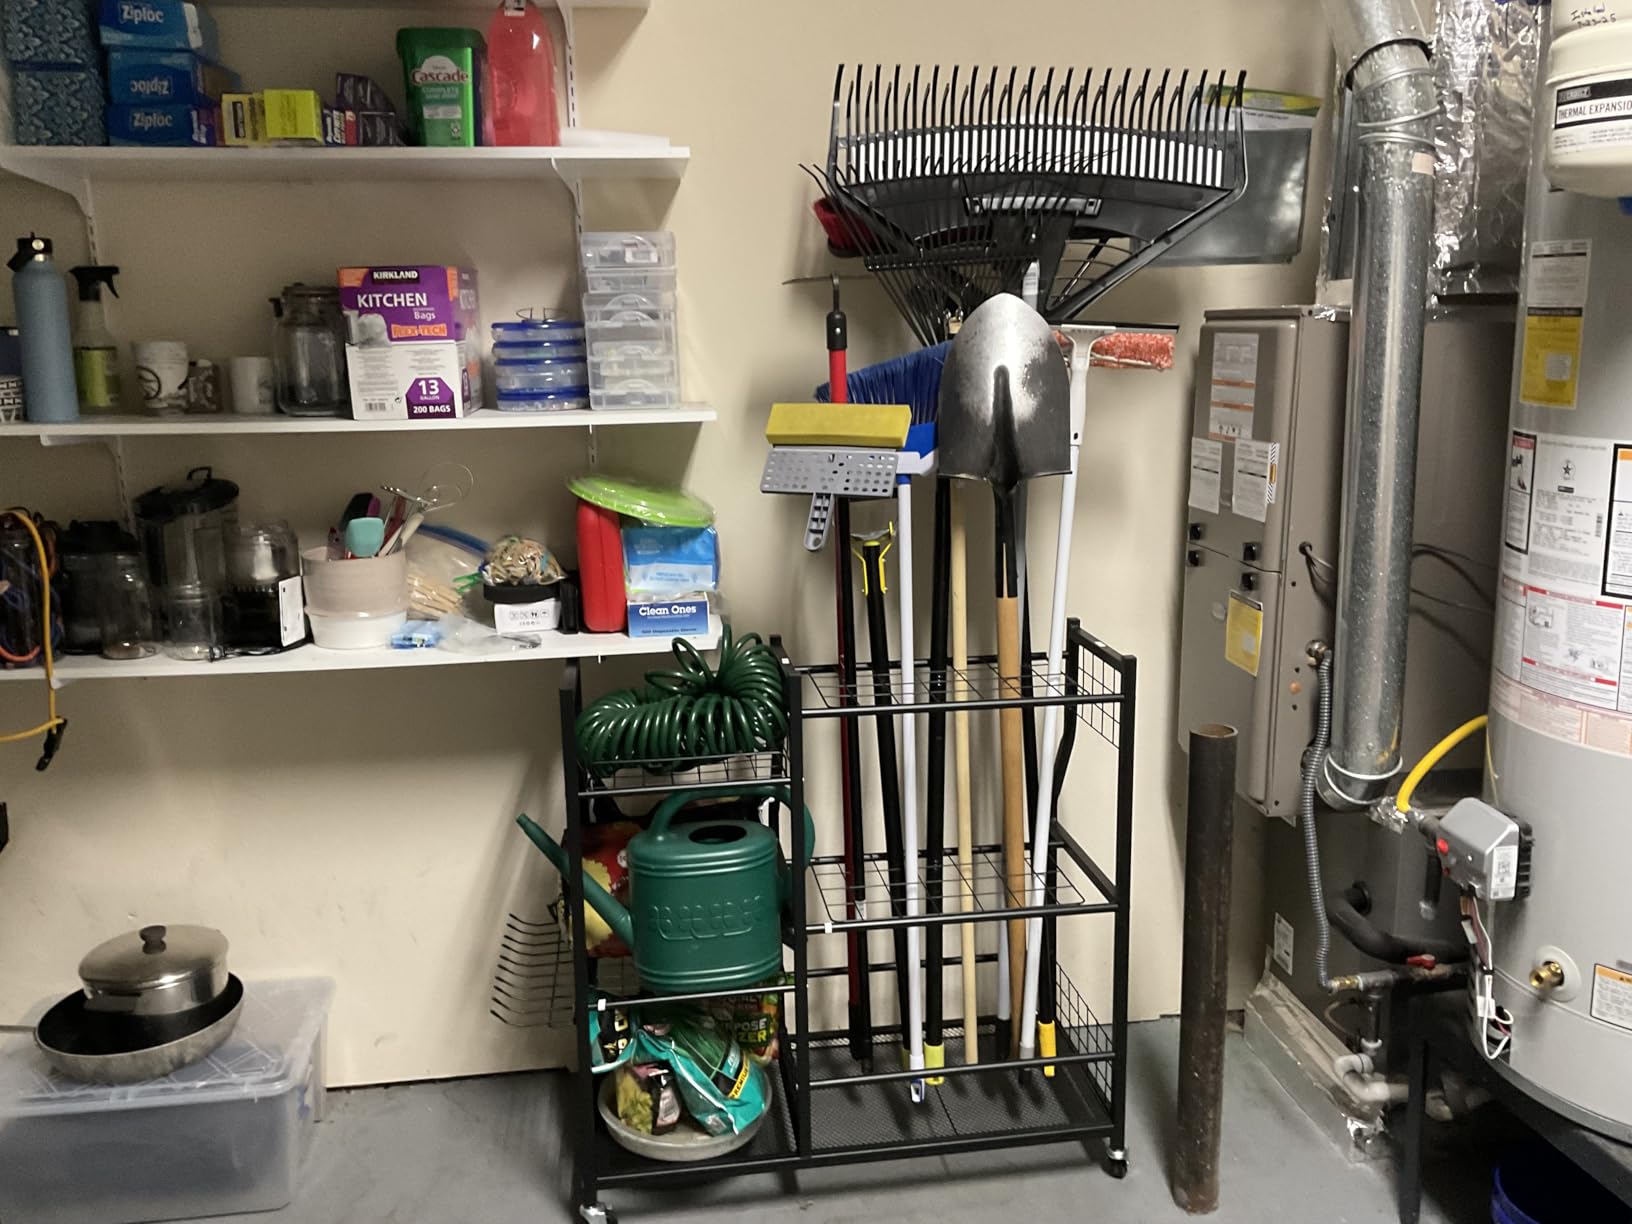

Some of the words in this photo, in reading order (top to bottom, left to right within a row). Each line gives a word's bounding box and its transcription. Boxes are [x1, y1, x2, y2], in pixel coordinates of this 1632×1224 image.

[121, 4, 164, 24] Ziploc
[412, 69, 469, 85] Cascade
[130, 76, 169, 95] Ziploc
[1558, 105, 1587, 120] THERMAL
[133, 112, 173, 131] Ziploc
[373, 270, 418, 280] KIRKLAND
[357, 292, 428, 309] KITCHEN
[414, 311, 436, 322] Bags
[418, 379, 440, 395] 13
[413, 405, 428, 414] 200
[429, 404, 451, 413] BAGS
[638, 606, 669, 616] Clean
[671, 604, 697, 615] Ones
